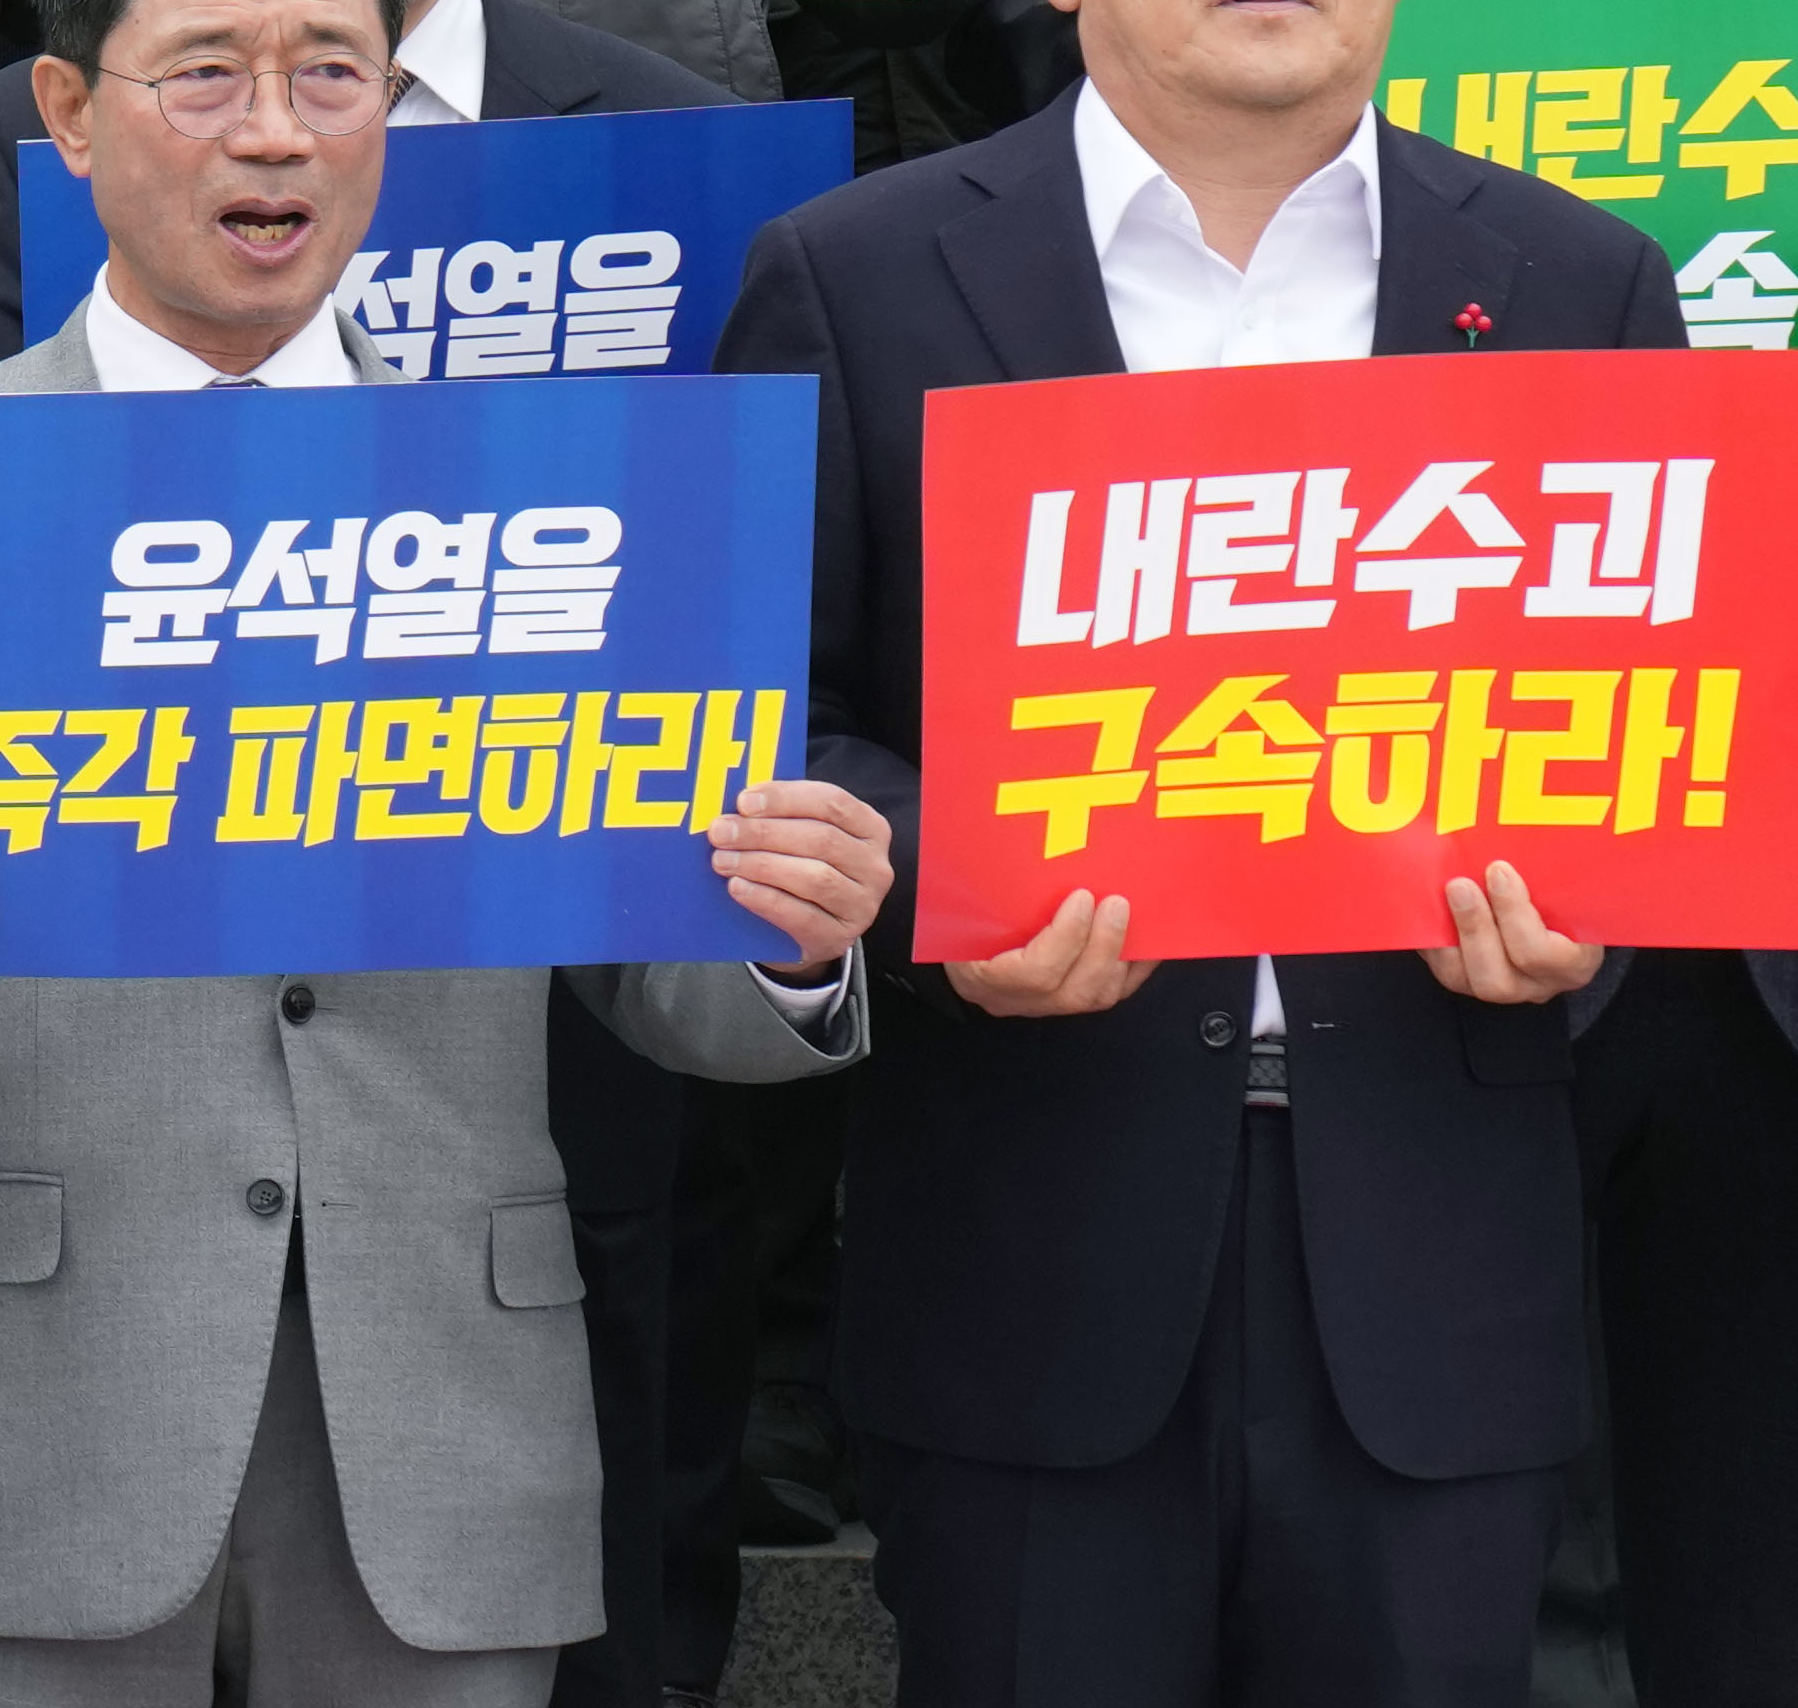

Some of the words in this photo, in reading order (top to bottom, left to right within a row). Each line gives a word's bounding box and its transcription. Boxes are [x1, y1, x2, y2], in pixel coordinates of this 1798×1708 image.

[100, 504, 624, 668] 윤석열을
[1016, 458, 1716, 649] 내란수괴
[995, 668, 1742, 860] 구속하라!
